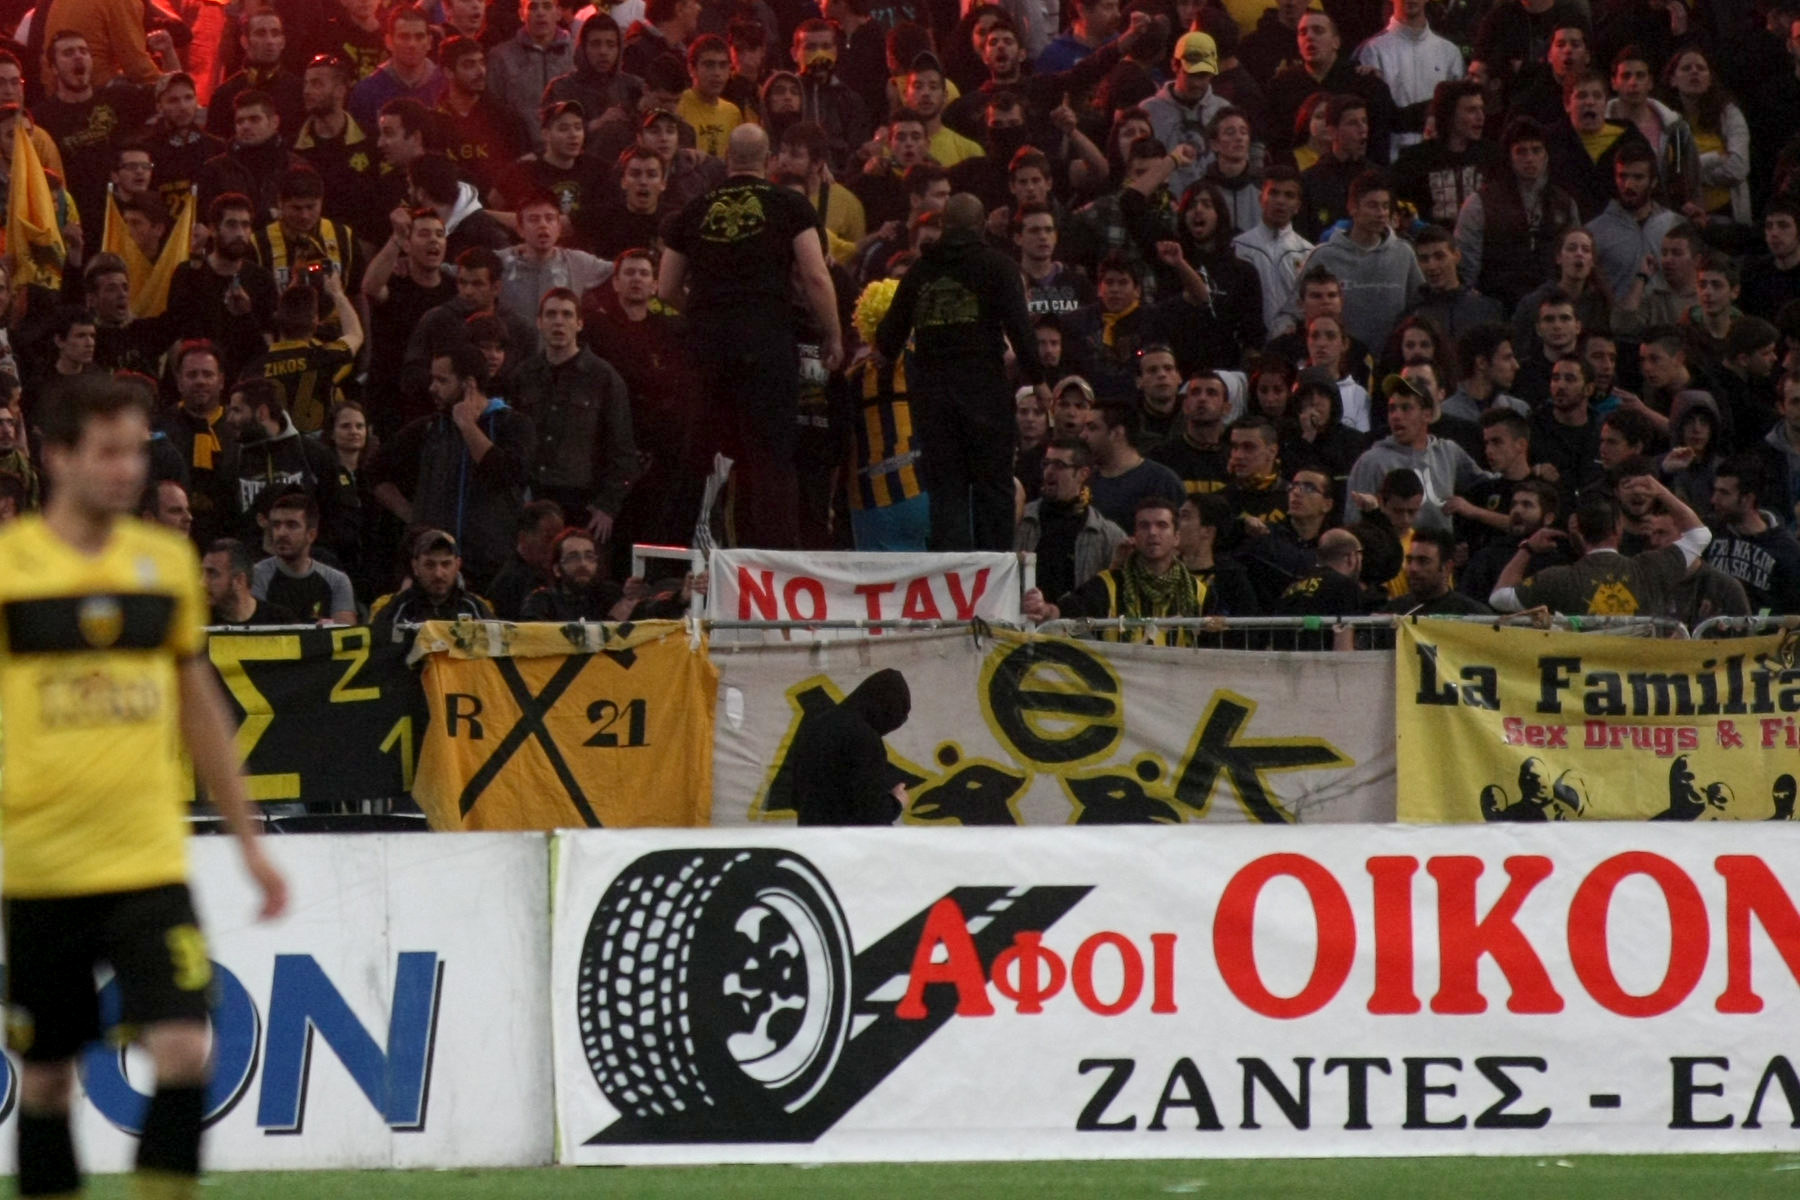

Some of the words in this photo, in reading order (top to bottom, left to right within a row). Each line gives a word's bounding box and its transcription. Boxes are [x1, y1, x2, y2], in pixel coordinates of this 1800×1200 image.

[263, 357, 308, 378] ZIKOS
[1710, 538, 1776, 572] FRNKLIN
[736, 566, 828, 636] NO
[855, 567, 990, 635] TAV
[1415, 642, 1501, 711] La
[581, 698, 651, 749] 21
[1502, 716, 1569, 749] Sex
[1584, 719, 1699, 758] Drugs
[1716, 719, 1744, 750] &
[1075, 1055, 1554, 1132] ΖΑΝΤΕΣ
